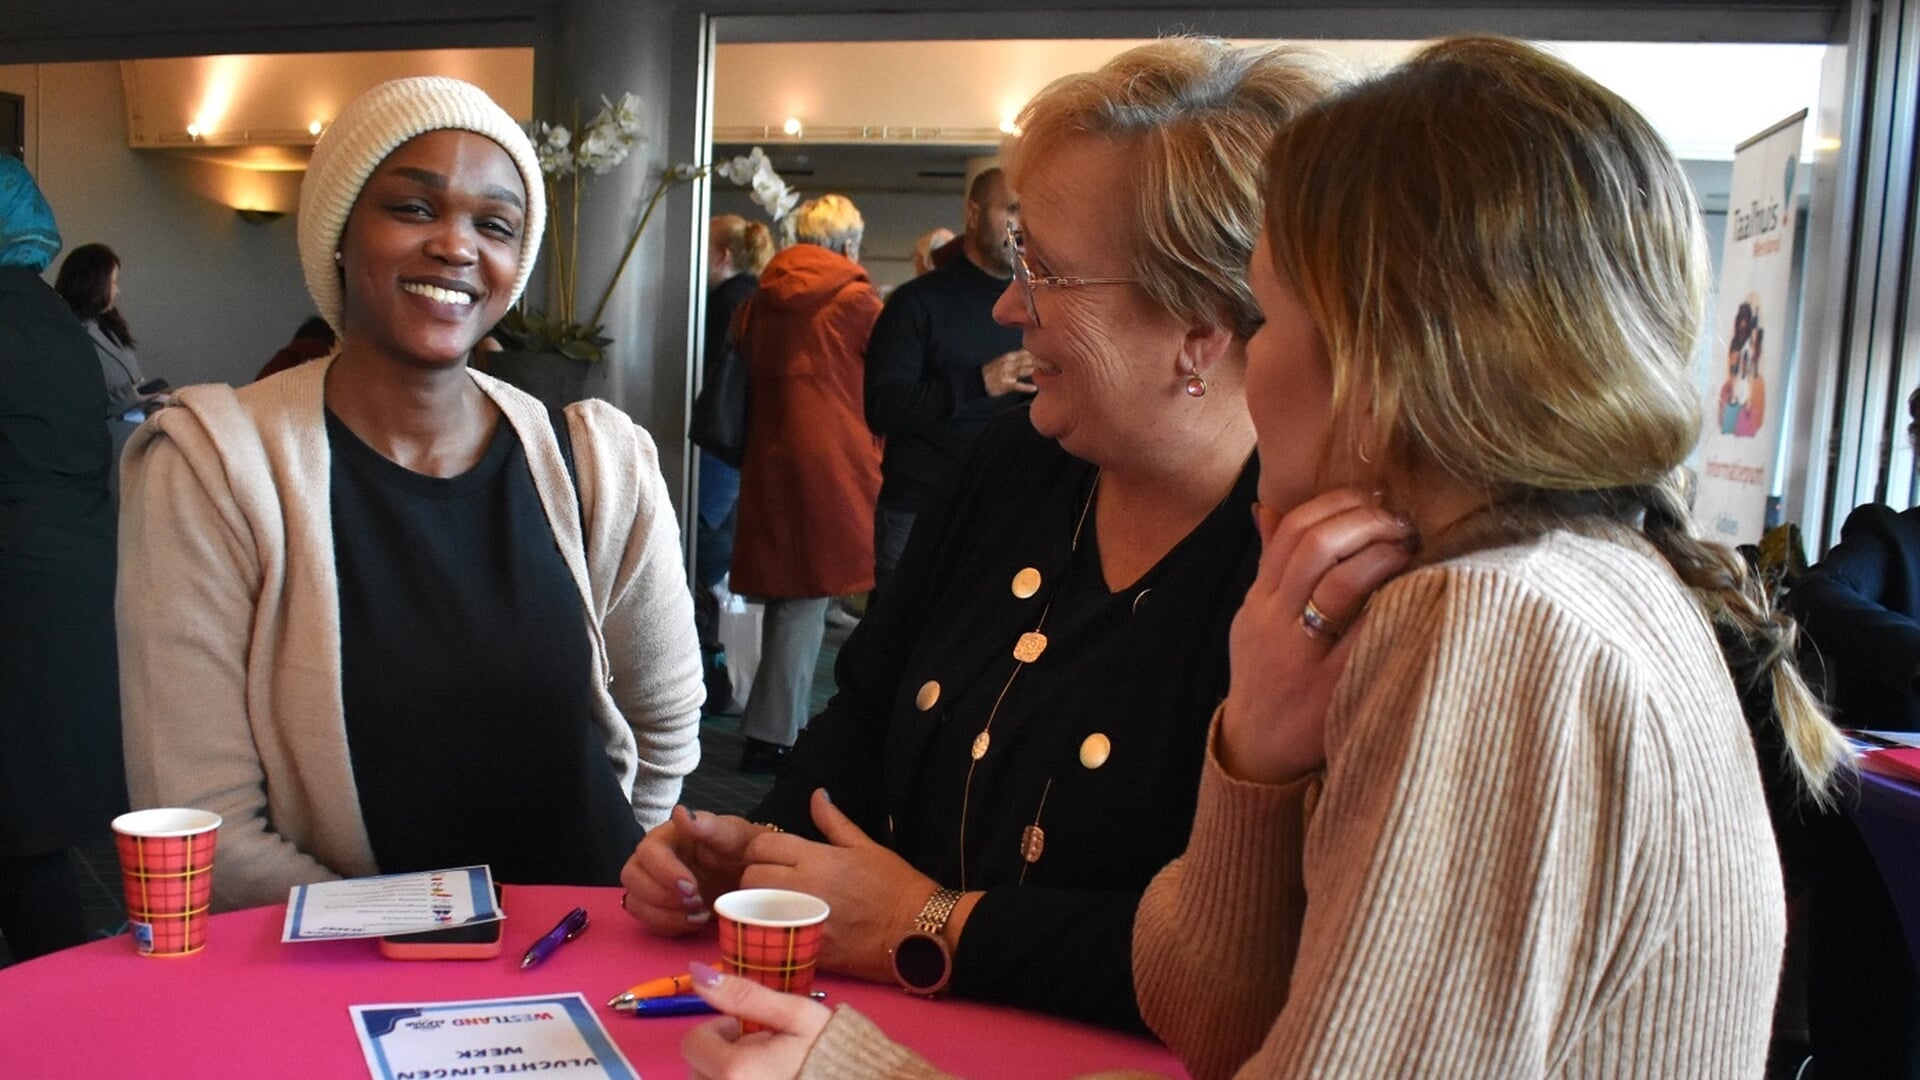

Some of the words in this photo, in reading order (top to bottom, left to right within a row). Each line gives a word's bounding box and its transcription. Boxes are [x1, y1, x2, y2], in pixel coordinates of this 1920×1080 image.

[452, 1012, 553, 1026] WESTLAND
[456, 1046, 523, 1059] WERK
[397, 1058, 598, 1079] VLUCHTELINGEN
